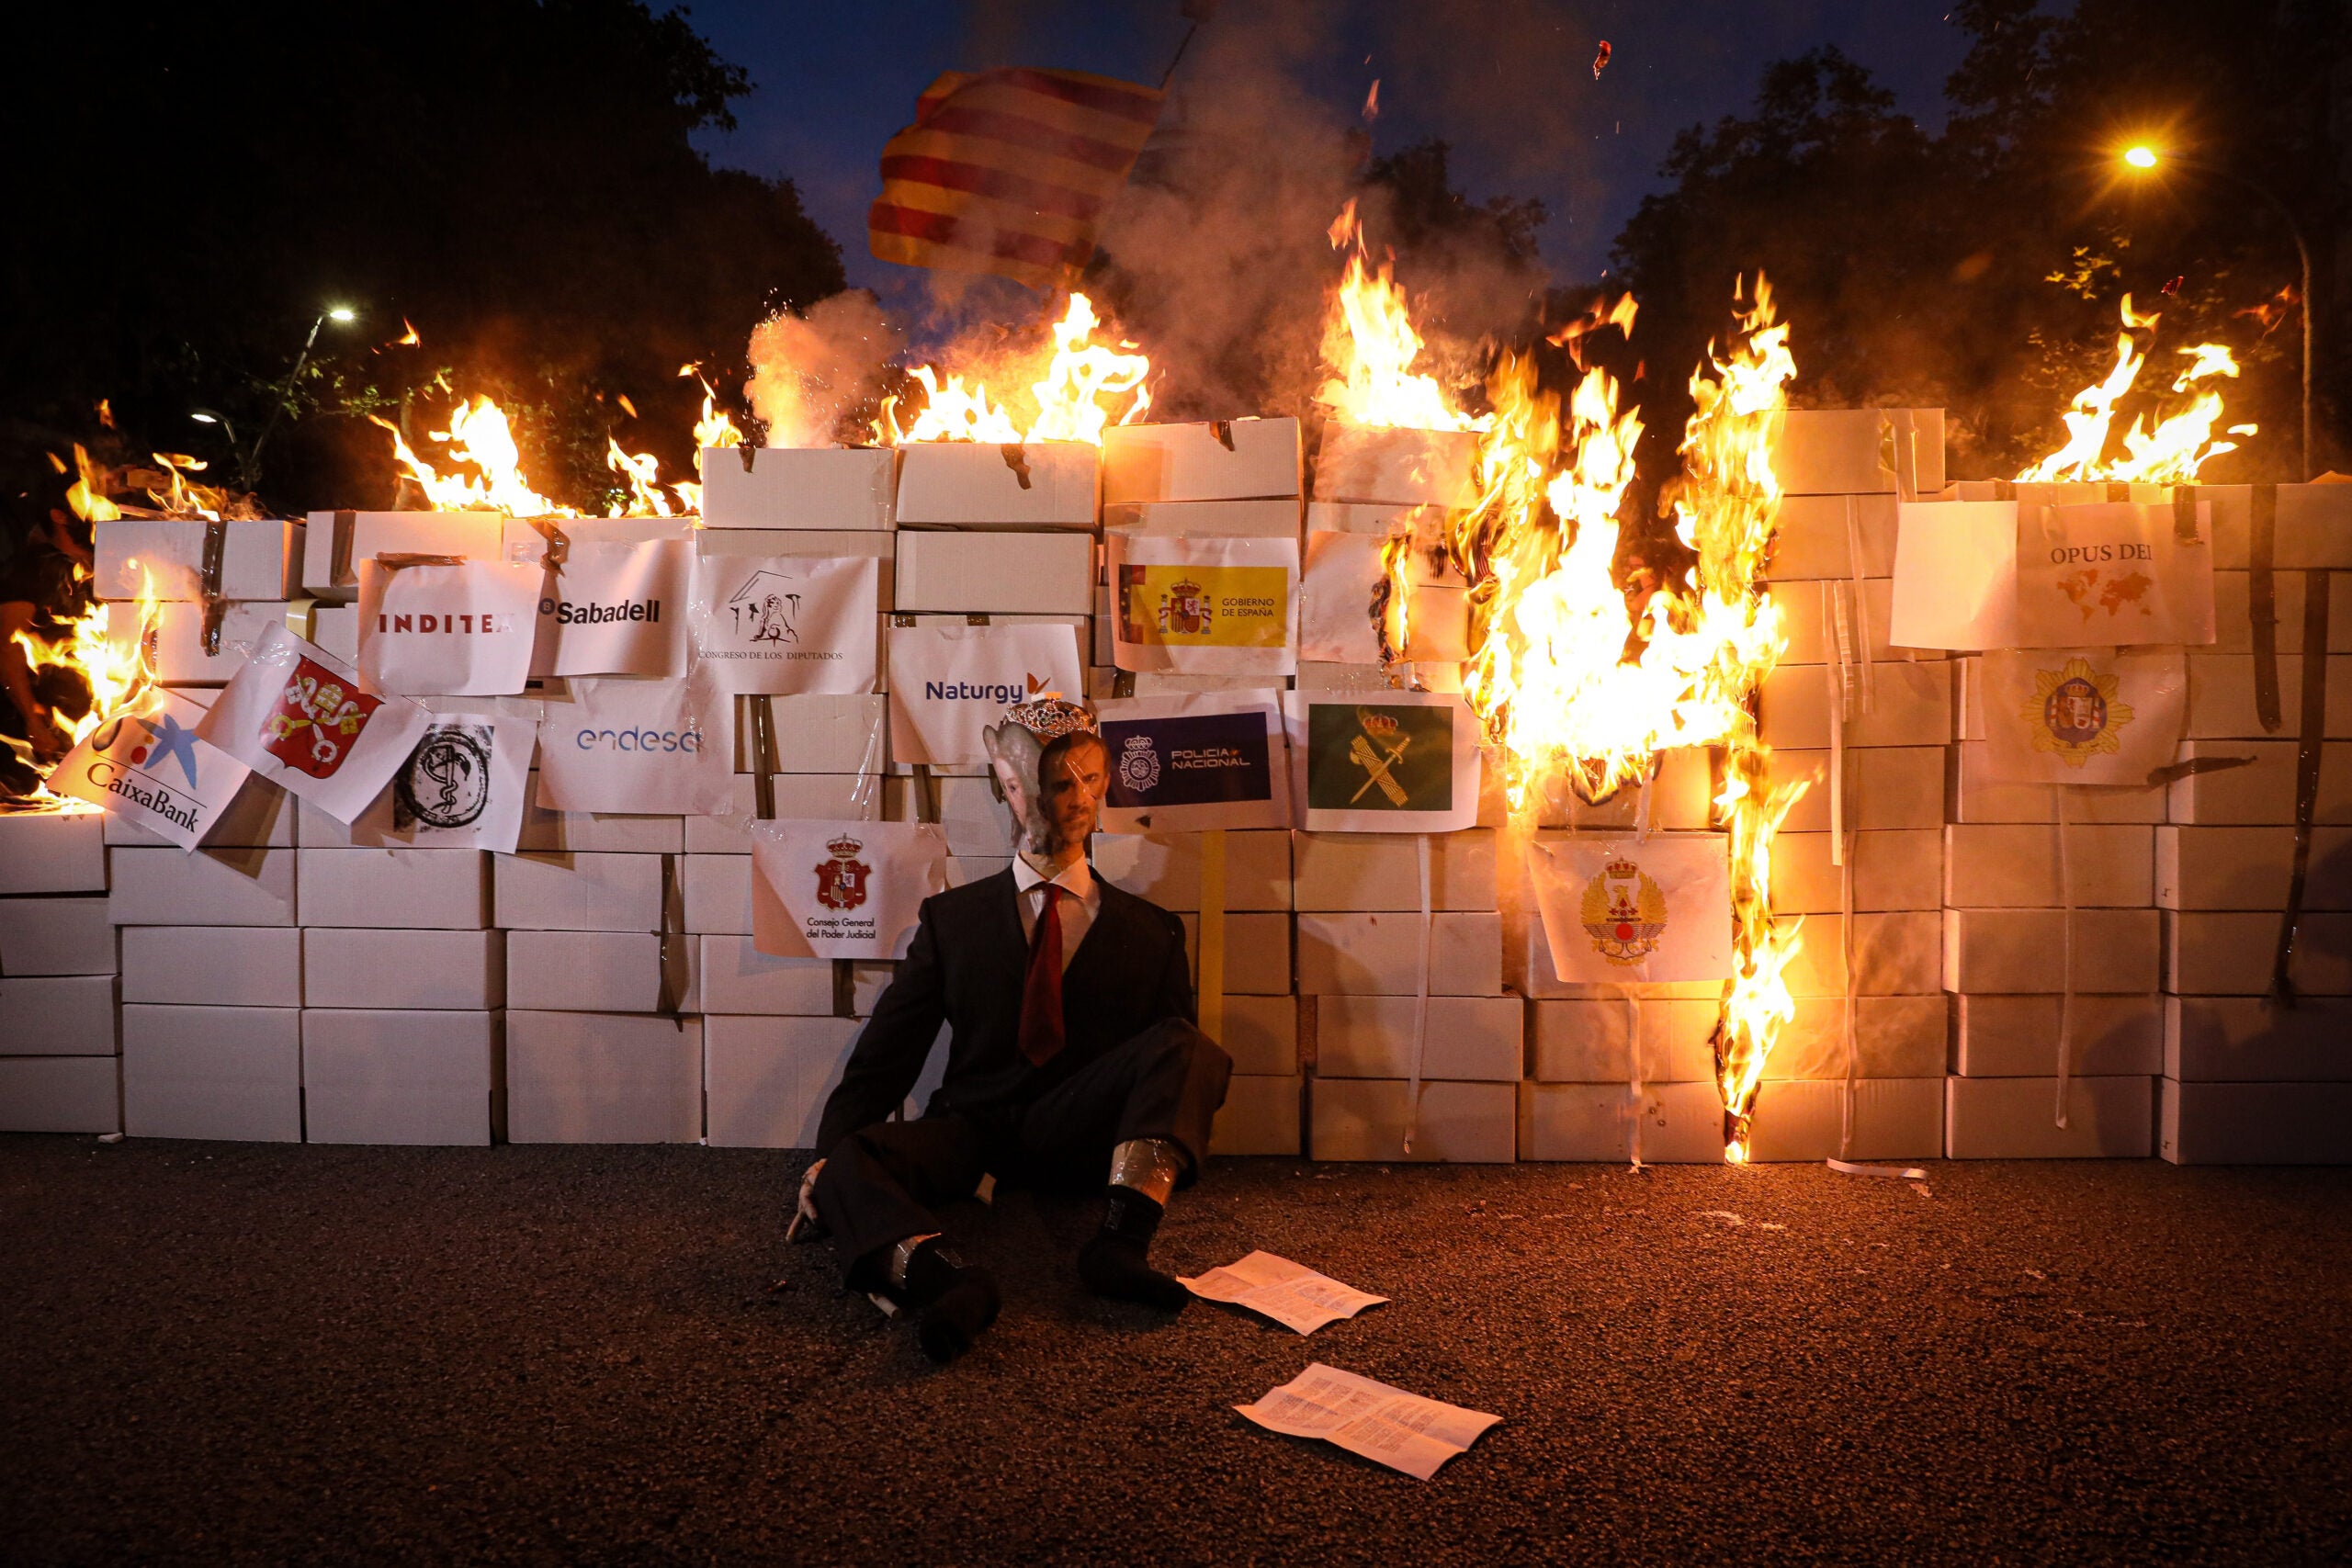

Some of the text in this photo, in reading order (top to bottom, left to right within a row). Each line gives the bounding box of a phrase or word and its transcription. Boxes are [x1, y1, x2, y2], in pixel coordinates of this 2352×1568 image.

[2050, 544, 2152, 564] OPUS DEI
[1222, 598, 1274, 606] GOBIERNO
[556, 599, 660, 625] Sabadell
[1238, 607, 1273, 616] ESPAÑA
[698, 651, 747, 660] CONGRESO
[787, 652, 843, 660] DIPUTADOS
[926, 682, 1023, 704] Naturgy
[577, 726, 701, 753] endesa
[1172, 758, 1251, 770] NACIONAL
[86, 763, 199, 833] CaixaBank
[807, 918, 875, 928] Consejo General
[807, 930, 876, 940] del Poder Judicial
